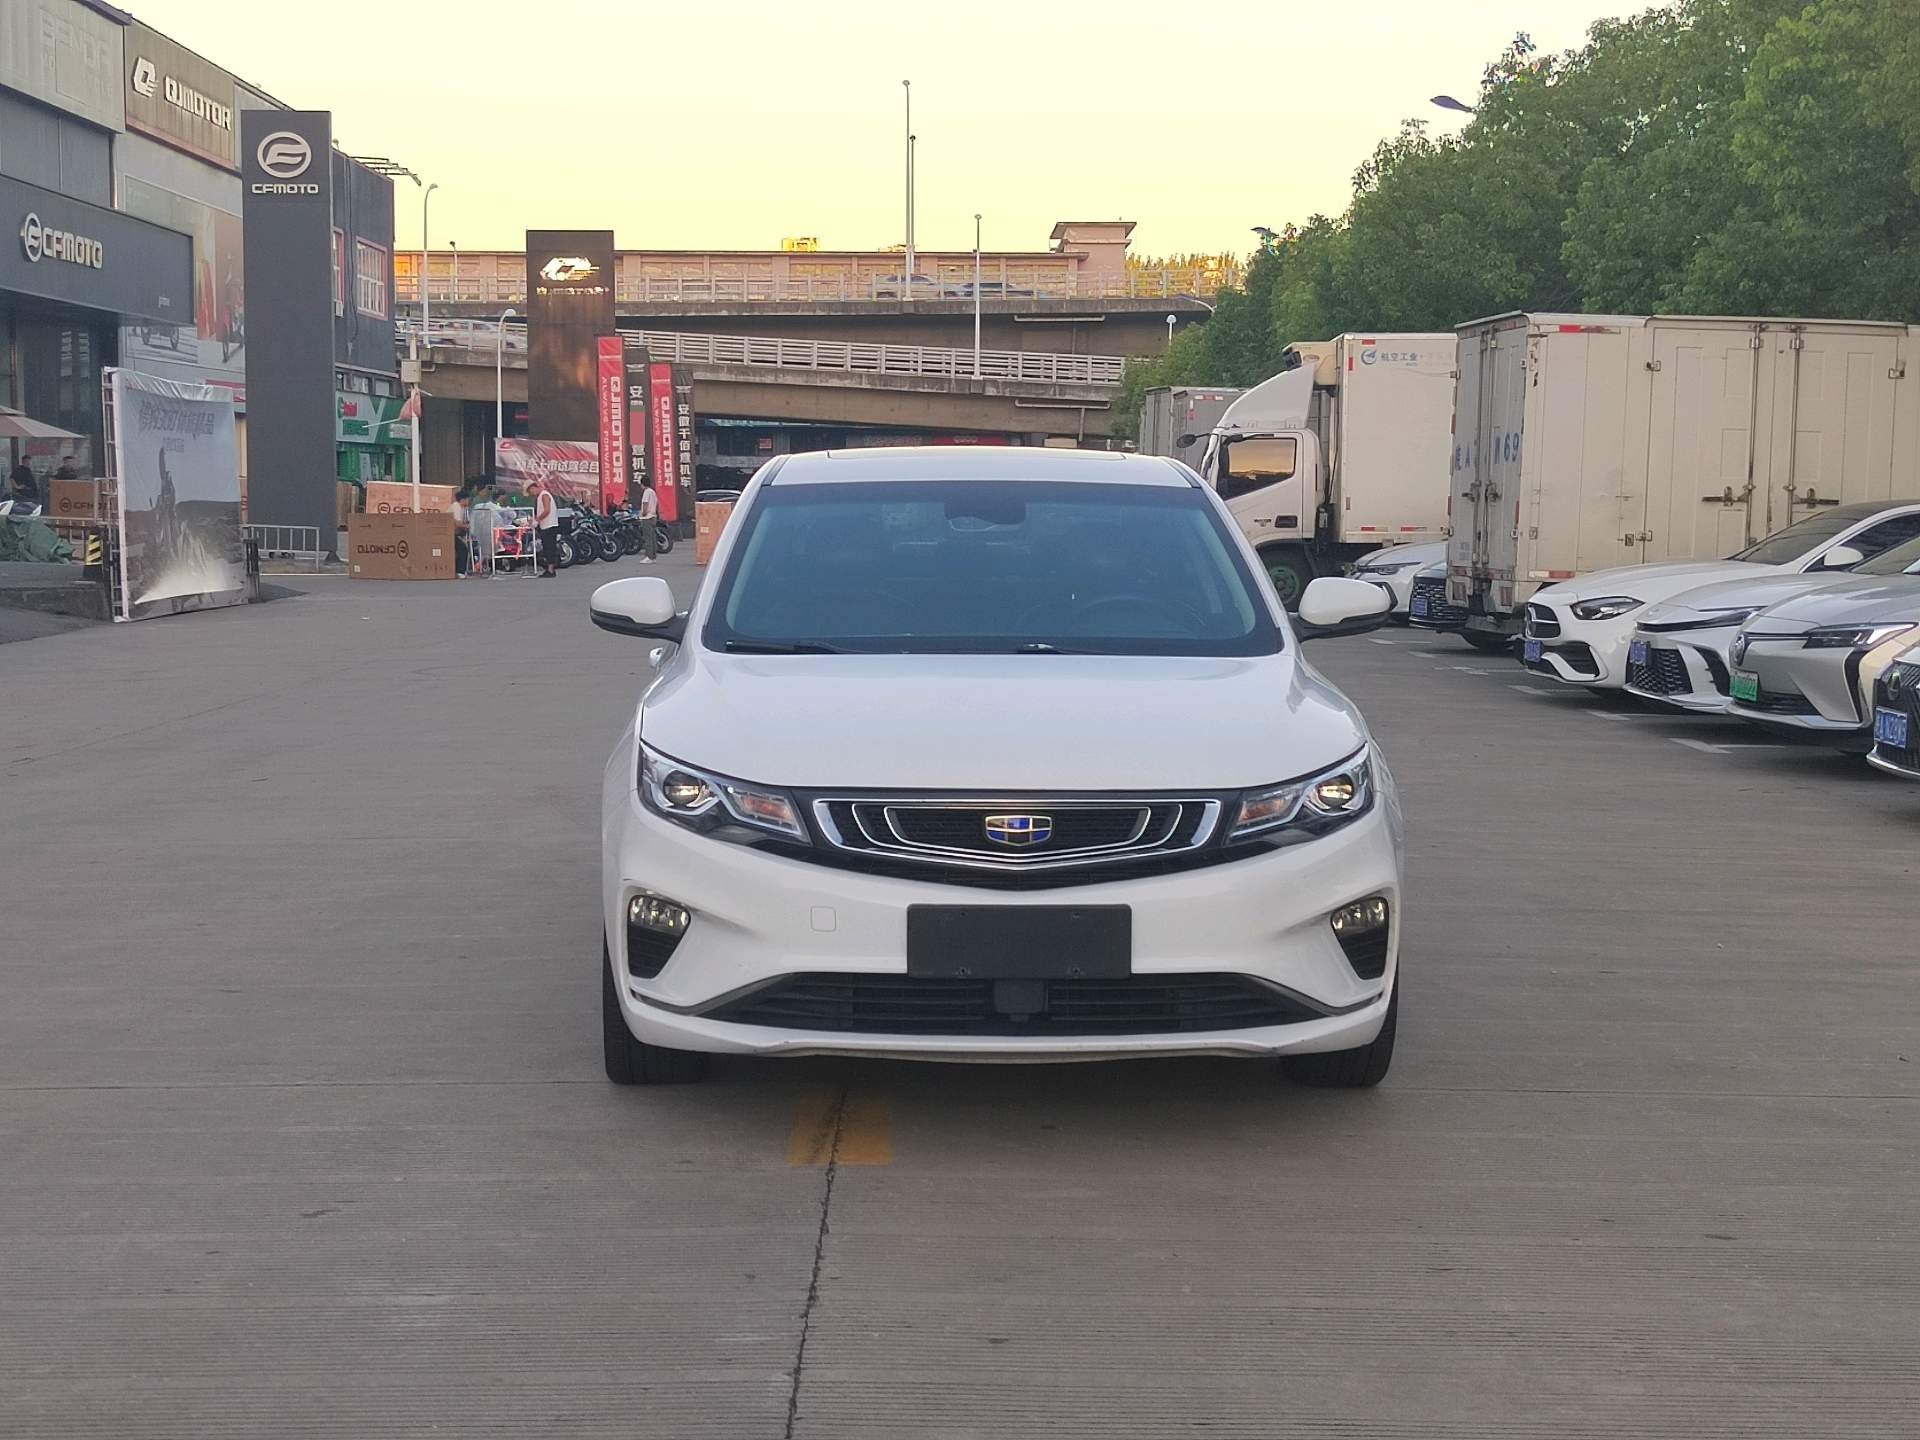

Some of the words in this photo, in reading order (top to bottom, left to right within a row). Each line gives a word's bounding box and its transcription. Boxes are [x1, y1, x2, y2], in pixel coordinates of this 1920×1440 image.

[164, 75, 233, 131] QJMOTOR
[251, 183, 319, 195] CFMOTO
[42, 226, 104, 269] CFMOTO
[610, 376, 623, 484] QJMOTOR
[661, 396, 673, 487] QJMOTOR
[357, 543, 396, 554] CFMOTO
